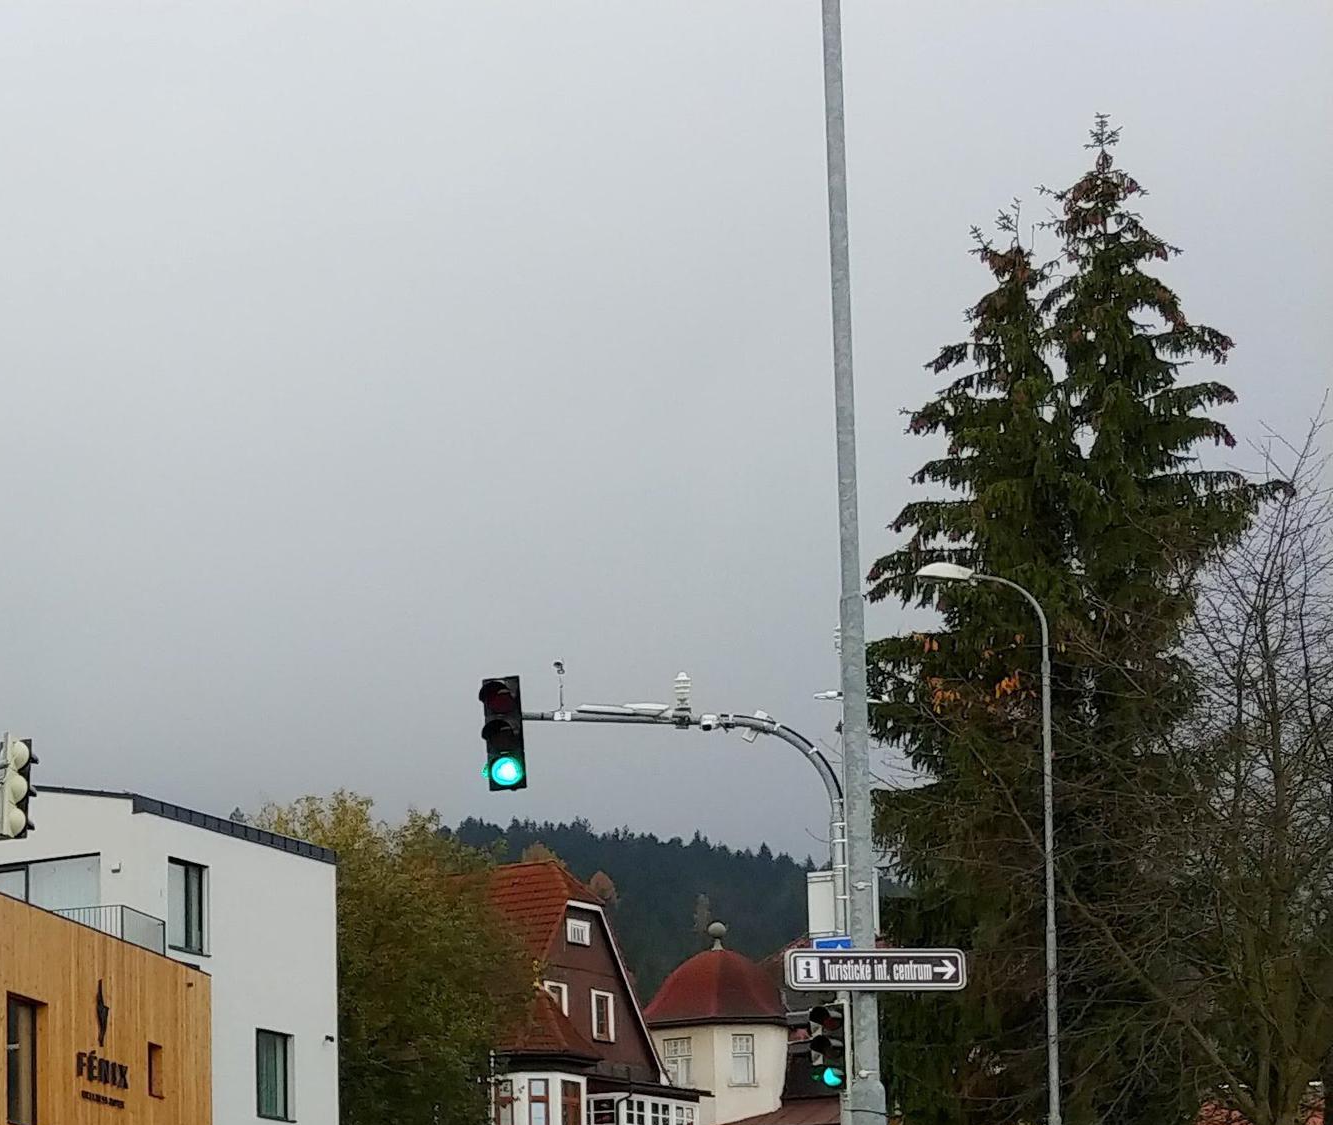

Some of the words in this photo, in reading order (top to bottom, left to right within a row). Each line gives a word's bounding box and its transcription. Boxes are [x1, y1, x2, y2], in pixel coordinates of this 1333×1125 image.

[822, 958, 871, 982] Turistické
[874, 959, 891, 981] inf.
[893, 959, 933, 981] centrum
[76, 1050, 129, 1090] FÉNIX
